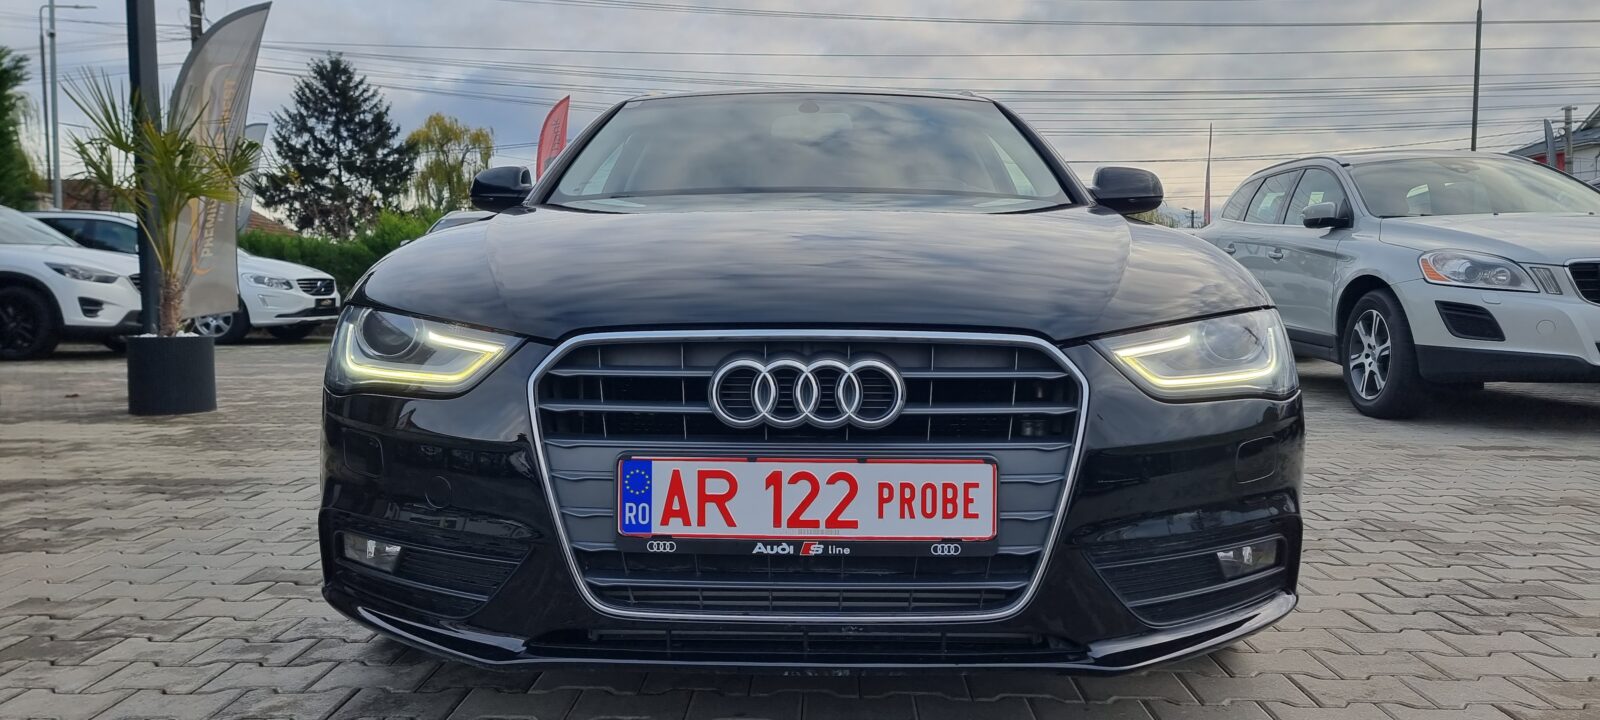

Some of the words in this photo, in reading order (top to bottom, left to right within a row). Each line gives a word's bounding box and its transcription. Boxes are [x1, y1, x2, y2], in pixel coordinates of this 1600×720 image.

[660, 469, 738, 527] AR
[765, 470, 858, 529] 122
[878, 482, 980, 519] PROBE
[625, 502, 650, 524] RO
[752, 543, 794, 555] Audi
[828, 545, 850, 555] line
